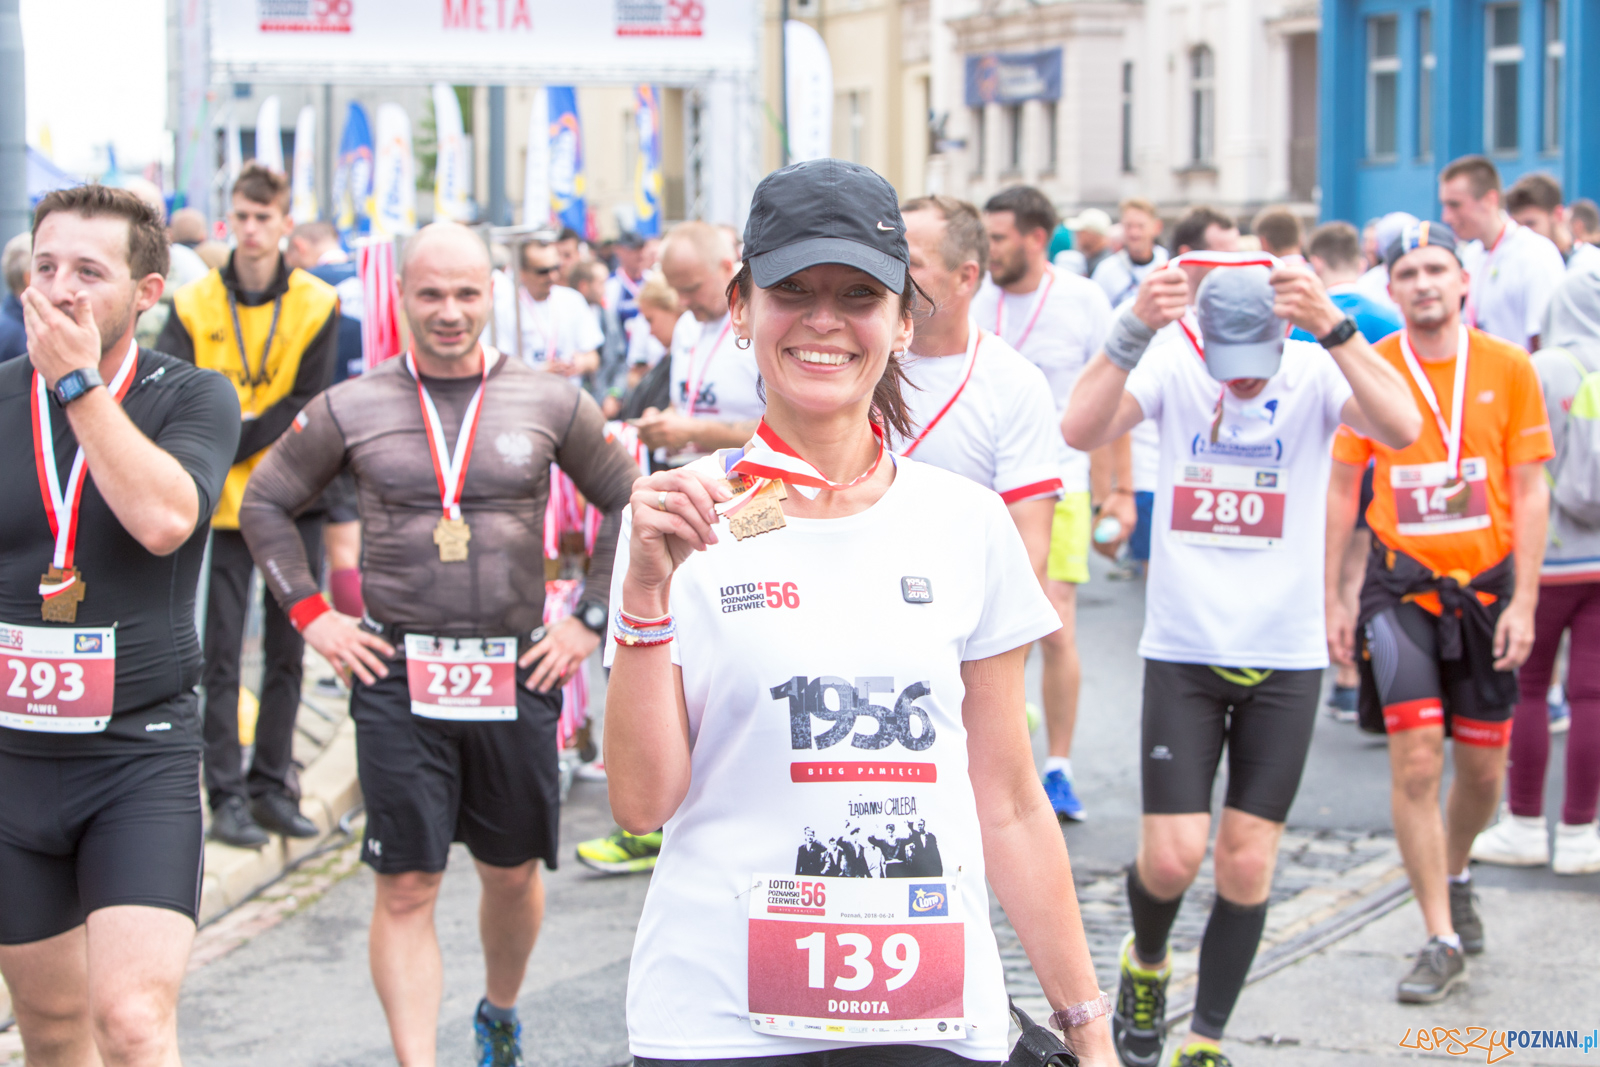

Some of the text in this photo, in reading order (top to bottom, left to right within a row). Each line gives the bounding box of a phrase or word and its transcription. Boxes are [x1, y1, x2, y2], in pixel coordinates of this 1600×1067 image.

[442, 0, 533, 31] META
[1191, 489, 1264, 525] 280
[720, 583, 756, 597] LOTTO
[908, 591, 930, 599] 2018
[721, 592, 765, 605] POZNAŃSKI
[722, 600, 766, 613] CZERWIEC
[7, 659, 85, 701] 293
[427, 663, 493, 695] 292
[770, 676, 936, 751] 1956
[808, 767, 920, 777] BIEG PAMIĘCI
[884, 797, 918, 816] CHLEBA
[769, 880, 795, 890] LOTTO
[767, 896, 800, 906] CZERWIEC
[919, 895, 939, 908] LOTTO
[796, 932, 920, 991] 139
[828, 999, 890, 1014] DOROTA
